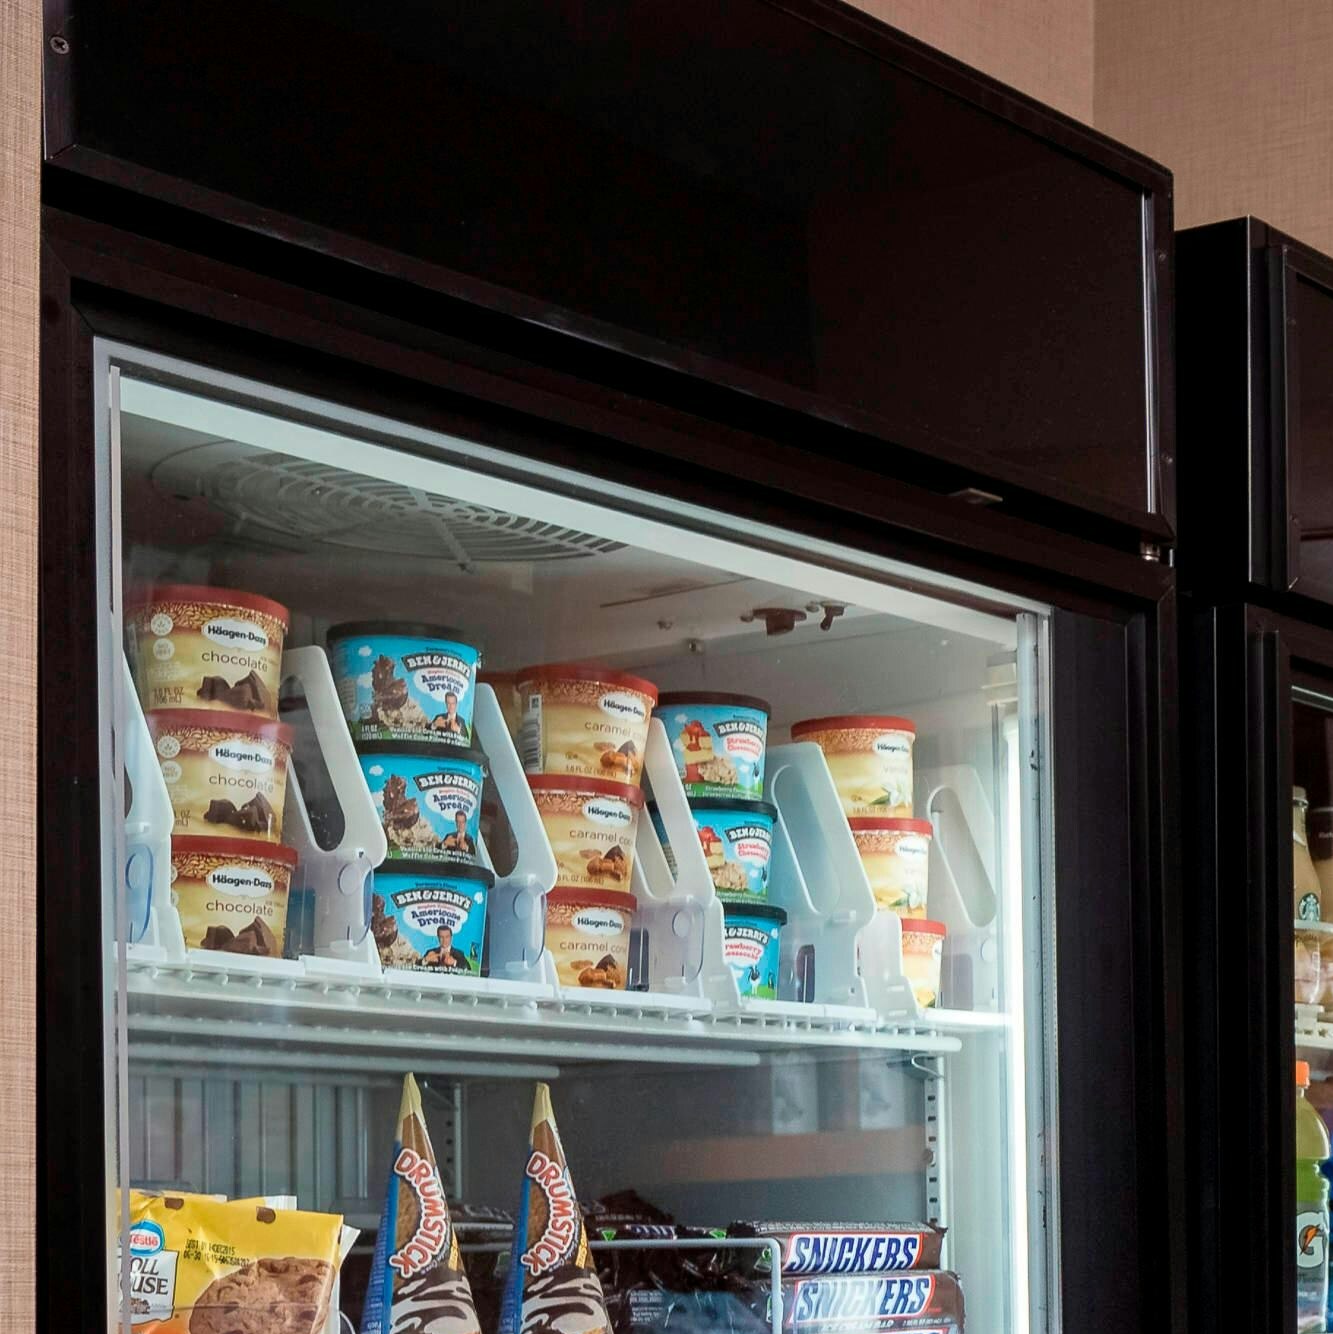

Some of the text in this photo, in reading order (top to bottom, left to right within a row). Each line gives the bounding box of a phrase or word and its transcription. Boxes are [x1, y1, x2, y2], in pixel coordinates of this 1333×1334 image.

[202, 651, 268, 672] chocolate
[428, 683, 459, 693] Dream
[585, 720, 631, 737] caramel
[206, 900, 273, 916] chocolate
[389, 1149, 446, 1277] DRUMSTICK
[520, 1151, 576, 1278] DRUMSTICK
[787, 1236, 918, 1273] SNICKERS
